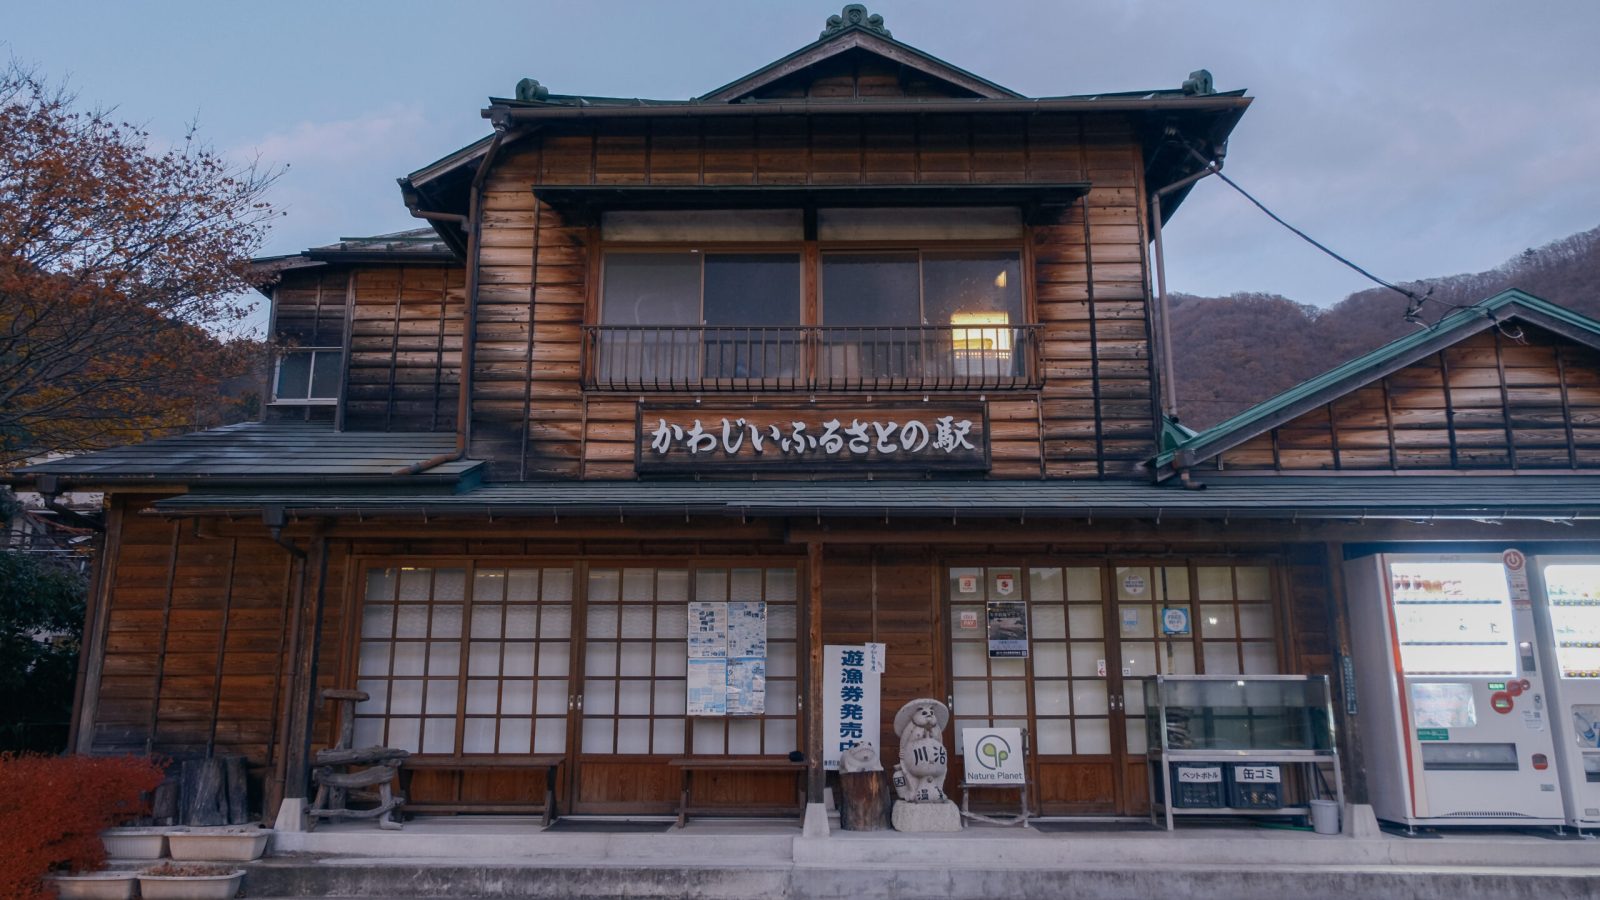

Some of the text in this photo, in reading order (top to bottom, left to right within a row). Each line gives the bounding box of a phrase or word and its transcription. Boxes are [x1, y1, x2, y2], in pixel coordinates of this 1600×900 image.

[651, 416, 975, 454] かわじいふるさとの駅
[913, 746, 945, 765] 川治
[968, 772, 1023, 780] Nature Planet
[1243, 768, 1274, 780] 缶ゴミ
